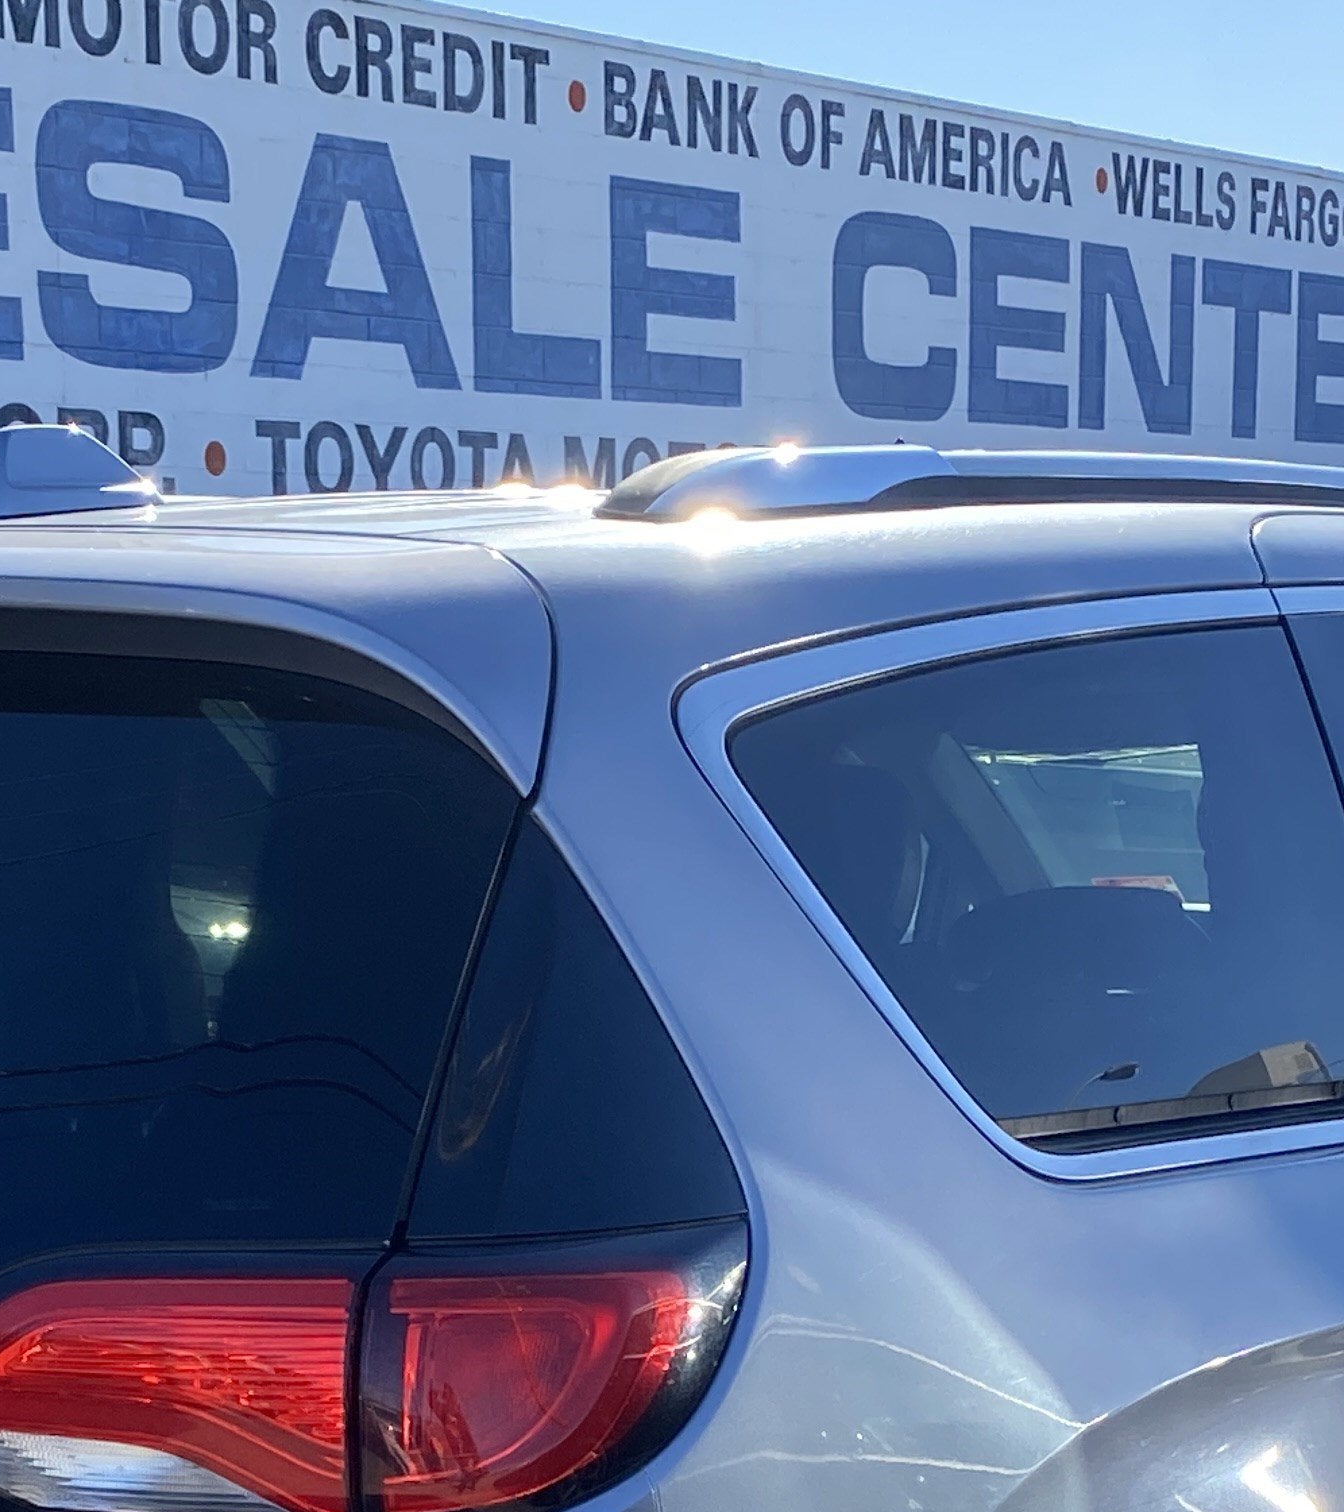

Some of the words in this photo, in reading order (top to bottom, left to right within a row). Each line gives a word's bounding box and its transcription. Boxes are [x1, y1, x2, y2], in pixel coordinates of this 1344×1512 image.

[305, 7, 549, 125] CREDIT
[603, 61, 758, 158] BANK
[780, 93, 846, 170] OF
[859, 108, 1073, 206] AMERICA
[1110, 152, 1236, 231] WELLS
[256, 419, 535, 495] TOYOTA
